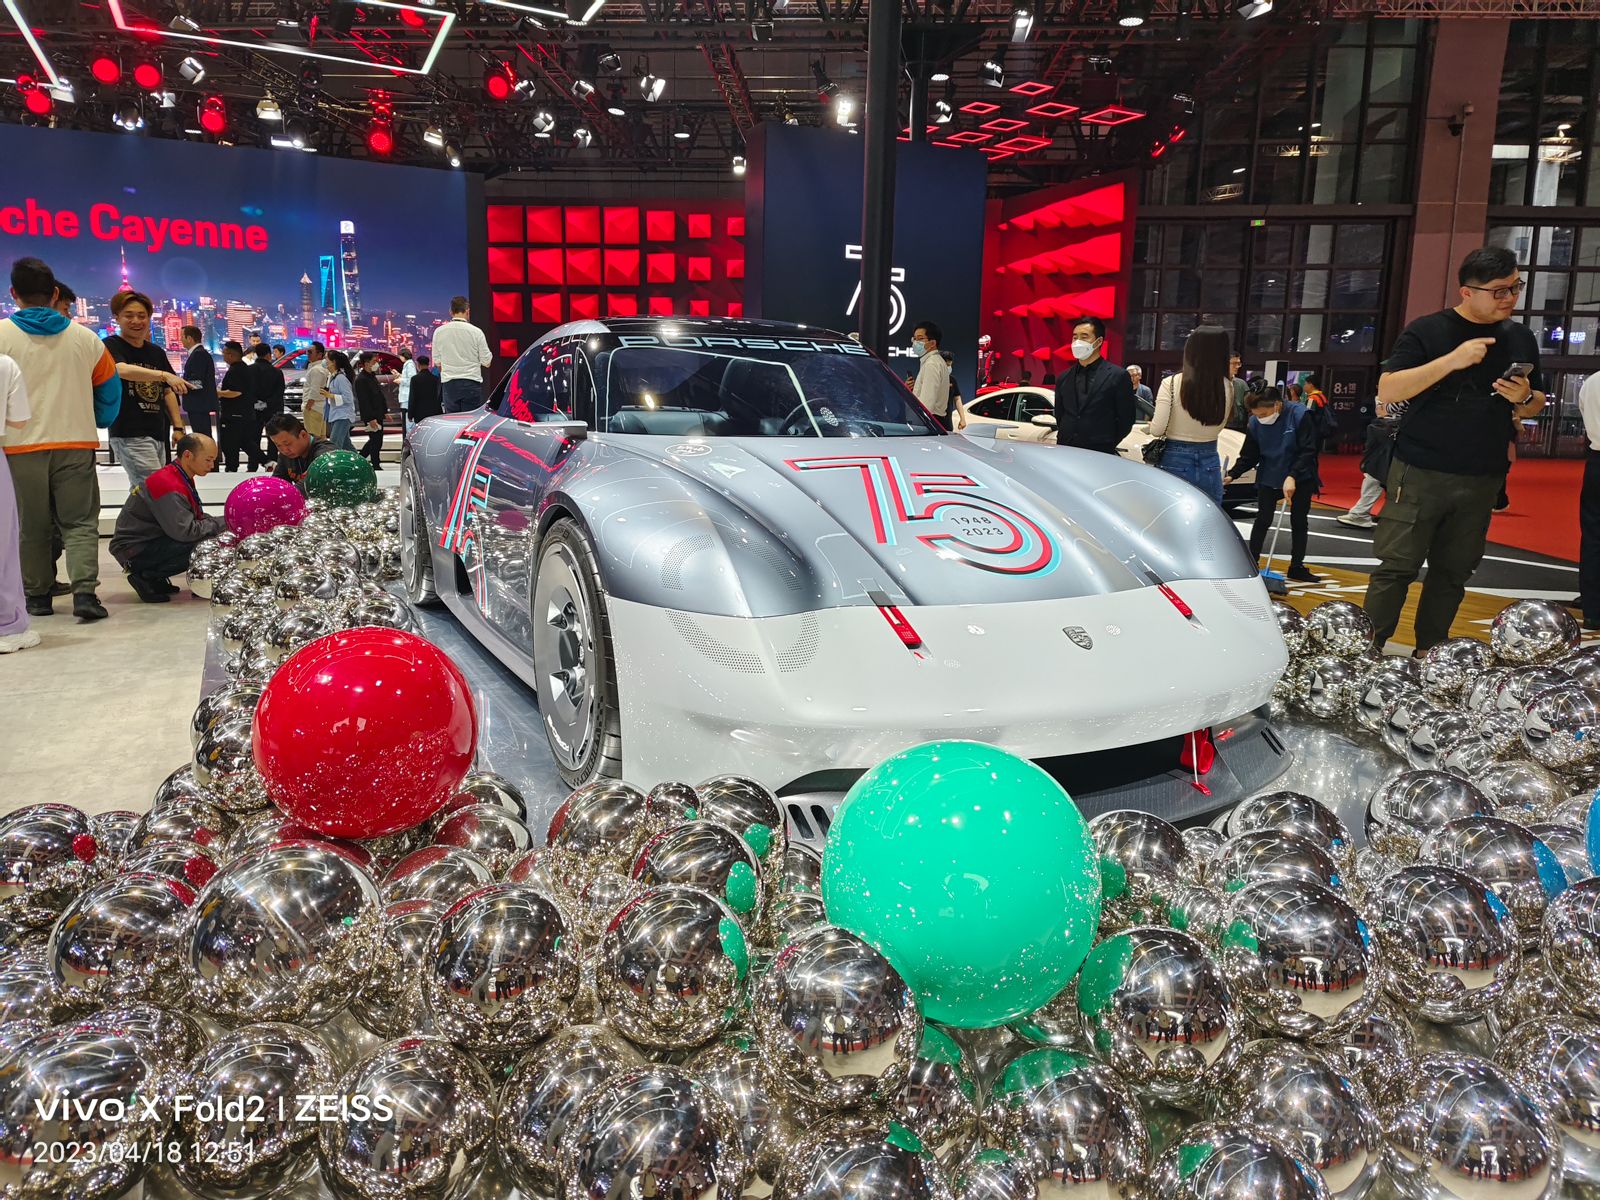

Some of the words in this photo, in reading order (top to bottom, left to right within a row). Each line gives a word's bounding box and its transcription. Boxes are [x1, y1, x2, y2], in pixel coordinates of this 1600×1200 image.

[0, 198, 79, 238] che
[89, 203, 268, 252] Cayenne
[618, 335, 870, 356] PORSCHE
[950, 516, 992, 525] 1948
[962, 527, 1004, 536] 2023
